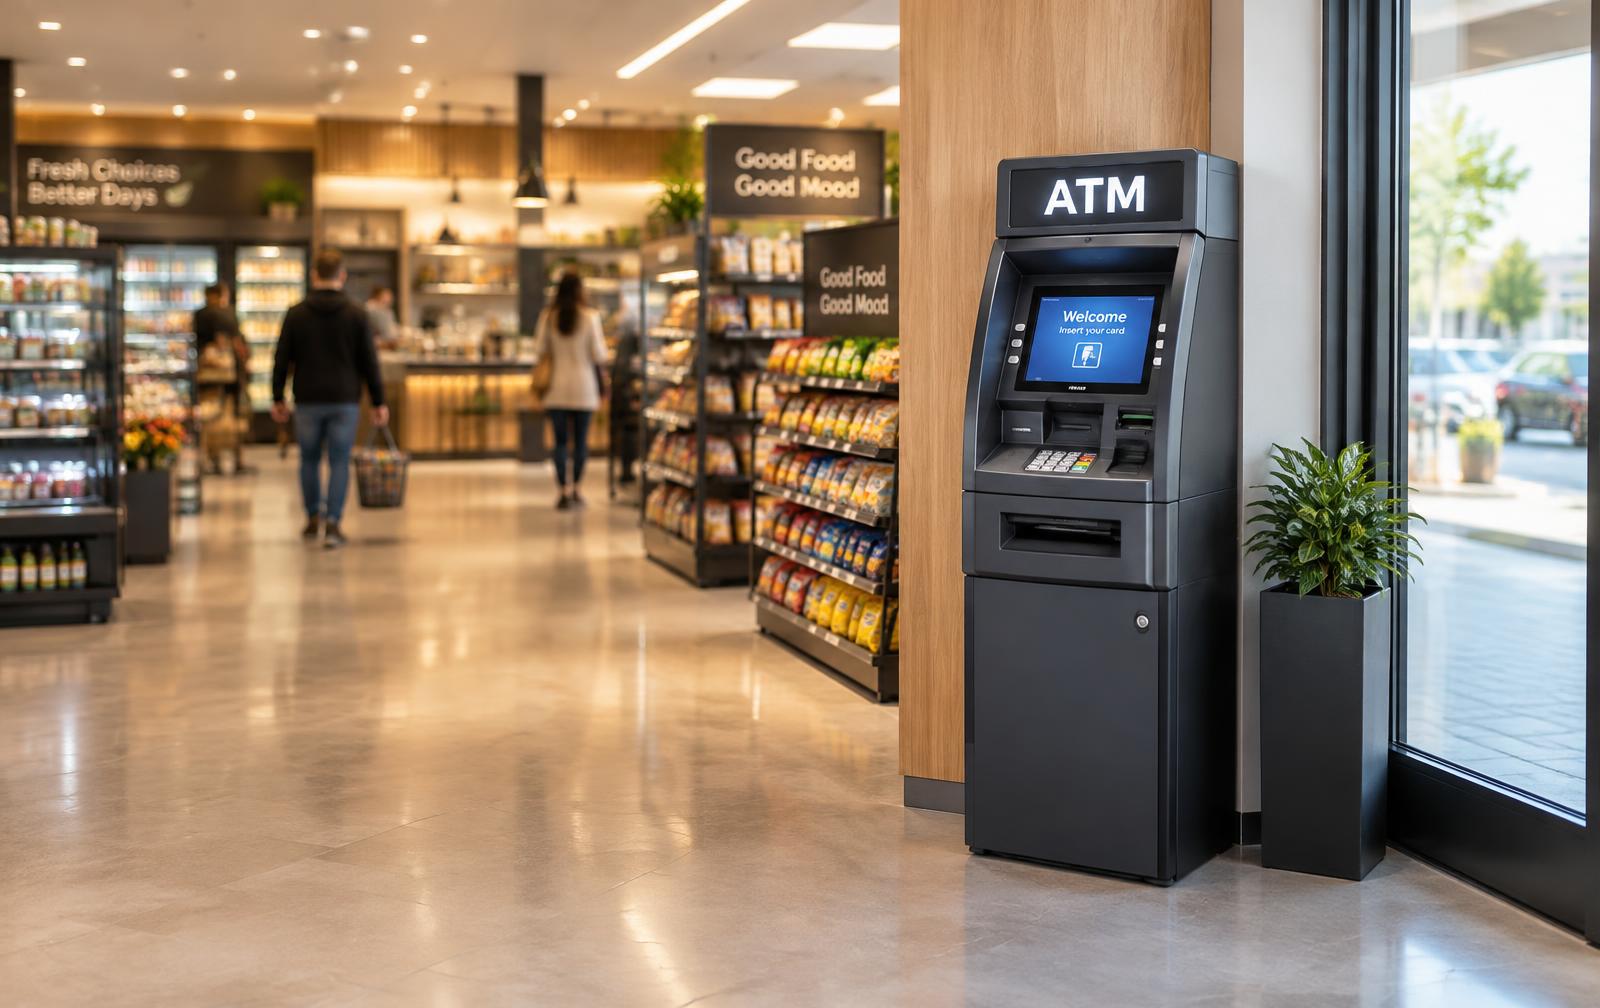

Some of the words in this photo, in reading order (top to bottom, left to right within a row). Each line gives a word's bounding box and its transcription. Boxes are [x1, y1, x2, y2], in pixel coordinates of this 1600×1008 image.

[27, 157, 88, 181] Fresh
[92, 158, 181, 184] Choices
[735, 147, 797, 170] Good
[801, 149, 856, 172] Food
[27, 182, 97, 206] Better
[101, 182, 158, 211] Days
[734, 174, 795, 197] Good
[800, 176, 860, 199] Mood
[1044, 175, 1145, 215] ATM
[820, 266, 853, 288] Good
[855, 264, 886, 287] Food
[820, 293, 853, 315] Good
[855, 293, 889, 316] Mood
[1063, 310, 1127, 323] Welcome
[1059, 326, 1084, 335] Insert
[1086, 328, 1104, 336] your
[1105, 327, 1125, 335] card
